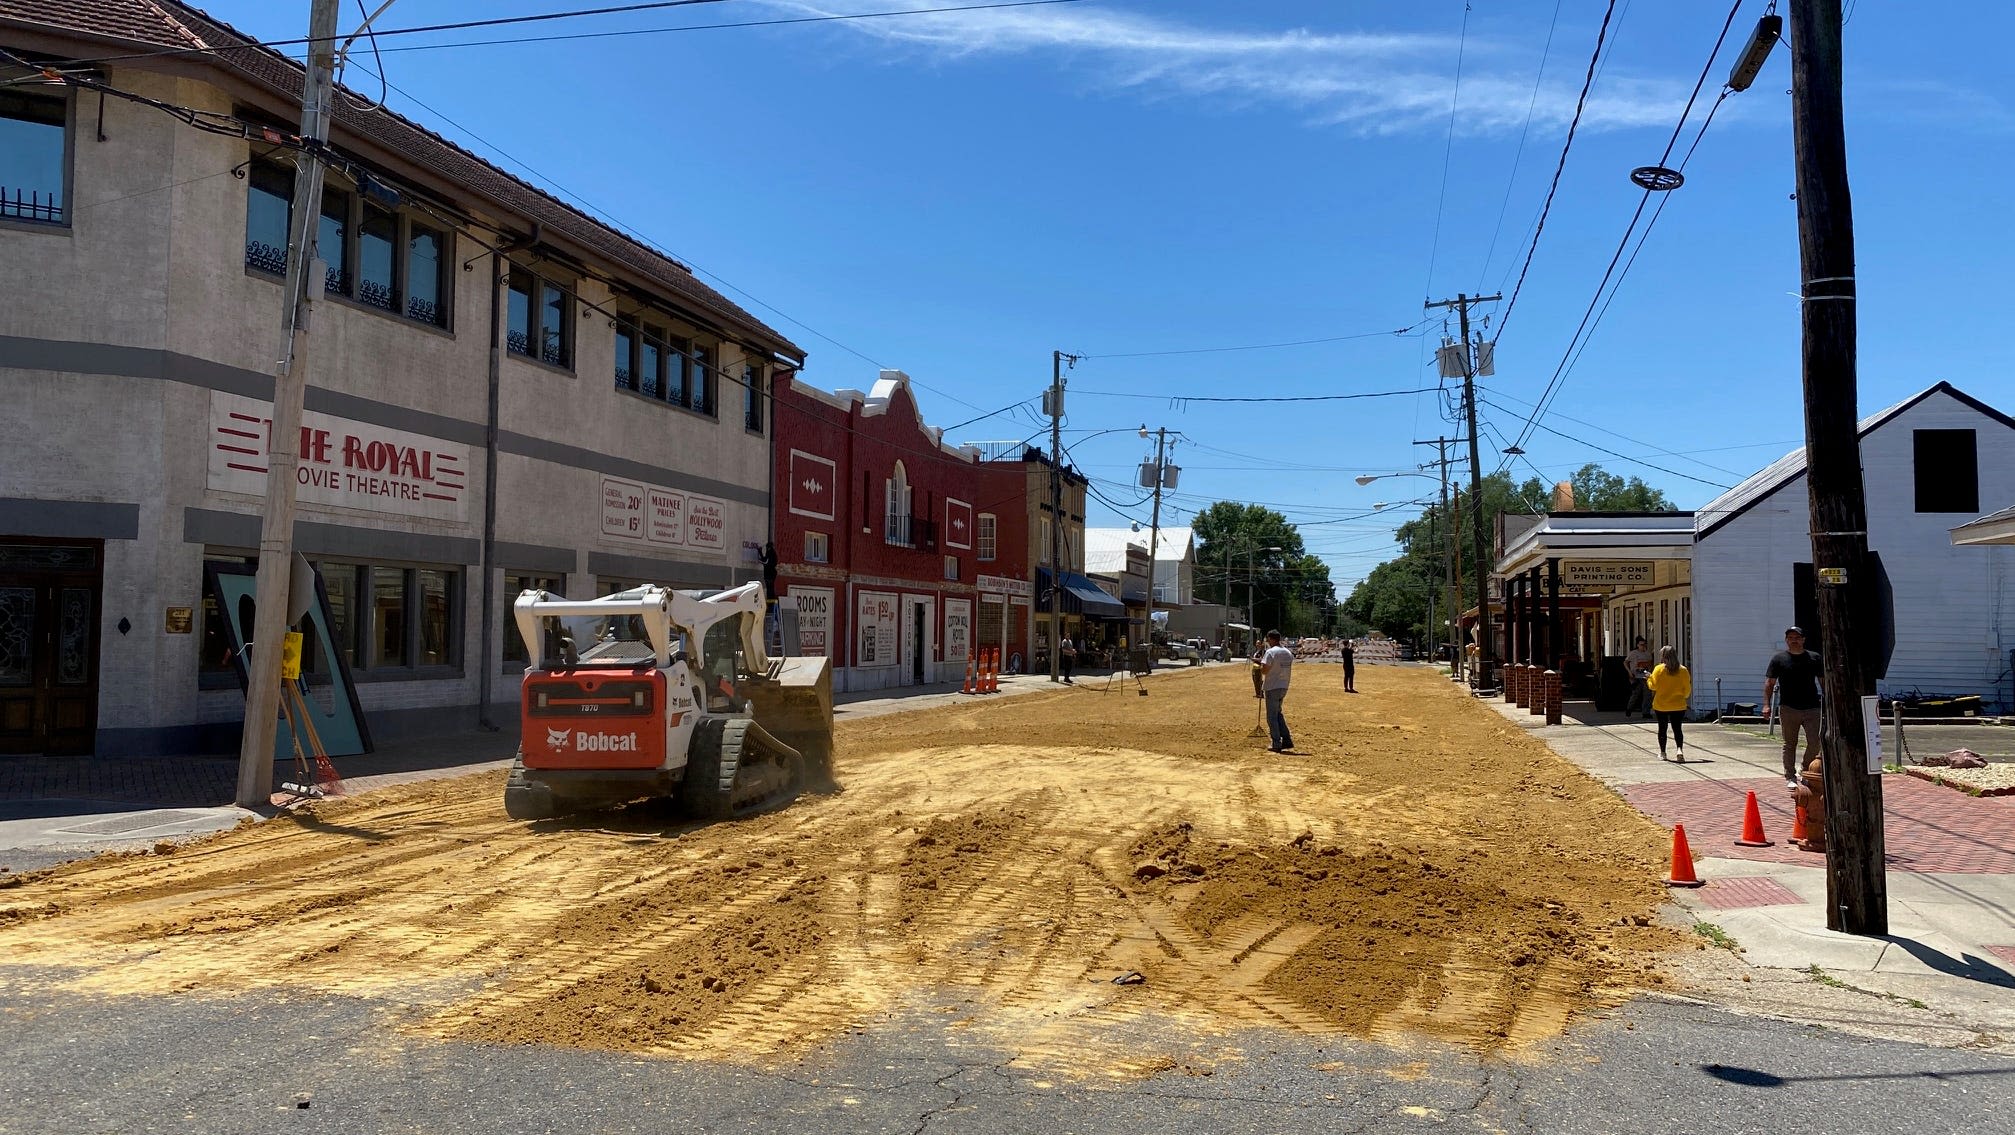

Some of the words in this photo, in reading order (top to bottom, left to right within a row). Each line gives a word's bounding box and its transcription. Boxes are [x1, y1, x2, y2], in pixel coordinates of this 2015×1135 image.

[342, 434, 435, 481] ROYAL
[297, 466, 340, 489] OVIE
[346, 473, 420, 500] THEATRE
[652, 495, 681, 510] MATINEE
[657, 508, 675, 518] PRICES
[689, 514, 723, 529] HOLLYWOOD
[796, 595, 827, 613] ROOMS
[809, 616, 827, 628] NIGHT
[799, 631, 824, 646] ARKING
[678, 697, 692, 709] Bobcat
[576, 731, 637, 752] Bobcat
